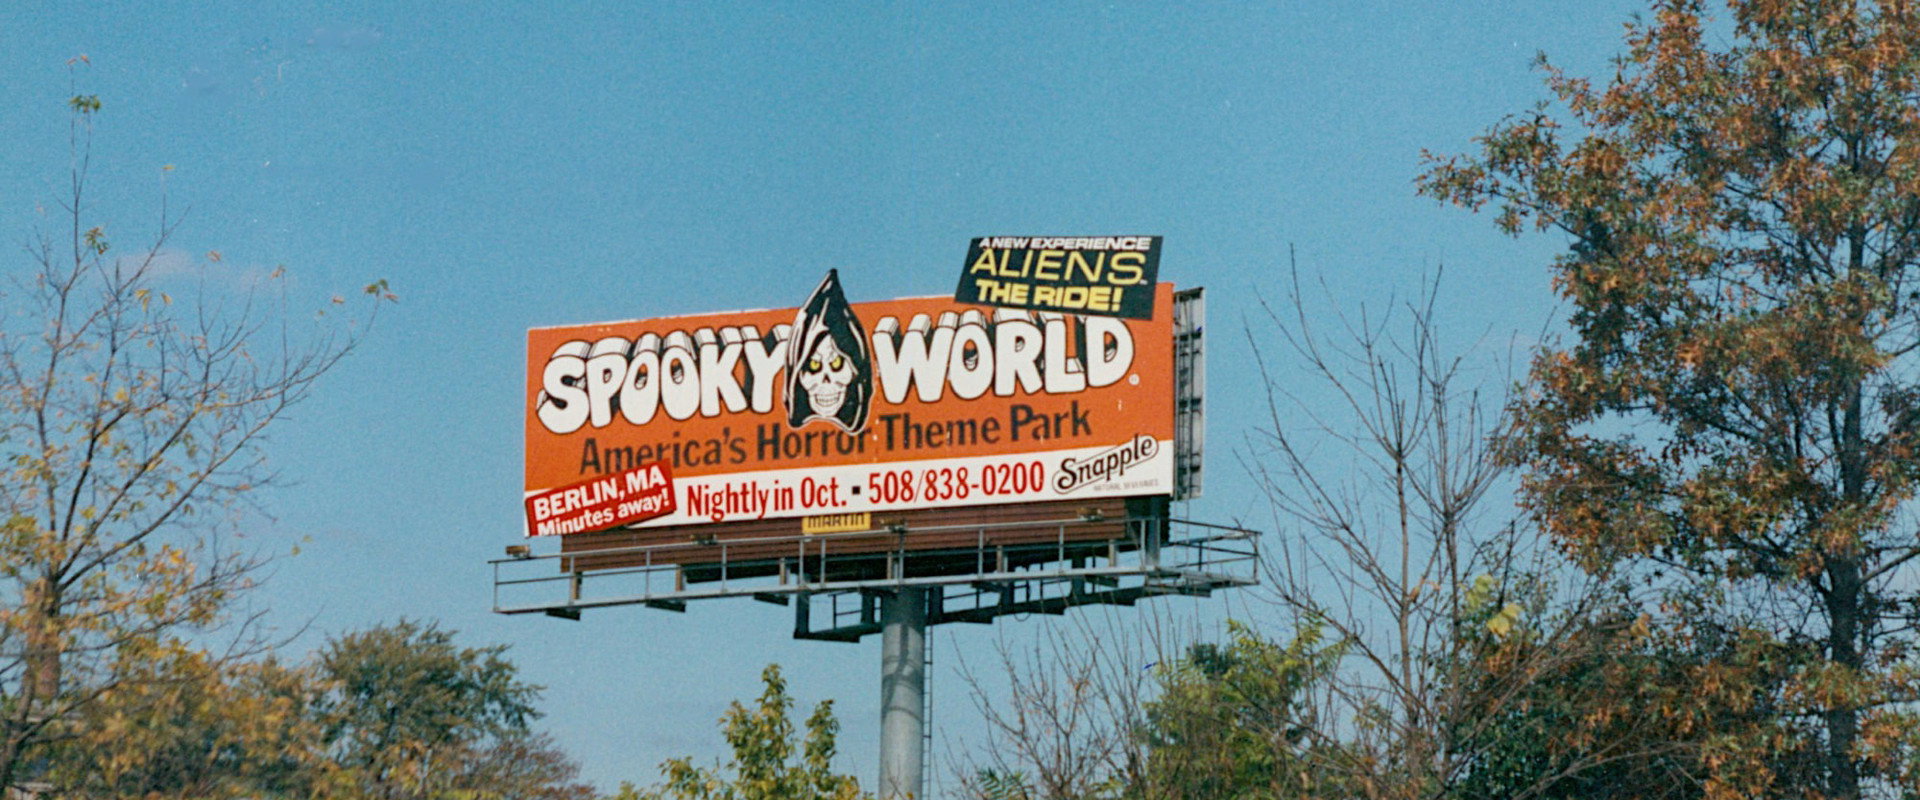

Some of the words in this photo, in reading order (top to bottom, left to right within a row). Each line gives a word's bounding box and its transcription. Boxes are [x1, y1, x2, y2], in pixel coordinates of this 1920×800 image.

[970, 248, 1146, 285] ALIENS
[979, 238, 991, 248] A
[992, 237, 1029, 249] NEW
[1030, 237, 1152, 251] EXPERIENCE
[975, 278, 1030, 305] THE
[1033, 286, 1124, 313] RIDE!
[537, 324, 790, 434] SPOOKY
[872, 308, 1134, 404] WORLD
[580, 427, 748, 475] America's
[757, 423, 873, 461] Horror
[879, 412, 1000, 452] Theme
[1009, 401, 1092, 442] Park
[1057, 432, 1153, 490] Snapple
[533, 477, 626, 522] BERLIN,
[625, 464, 667, 494] MA
[536, 507, 615, 536] Minutes
[617, 487, 671, 519] away!
[687, 481, 770, 523] Nightly
[774, 479, 795, 512] in
[800, 476, 848, 509] Oct.
[868, 460, 1045, 505] 508/838-0200
